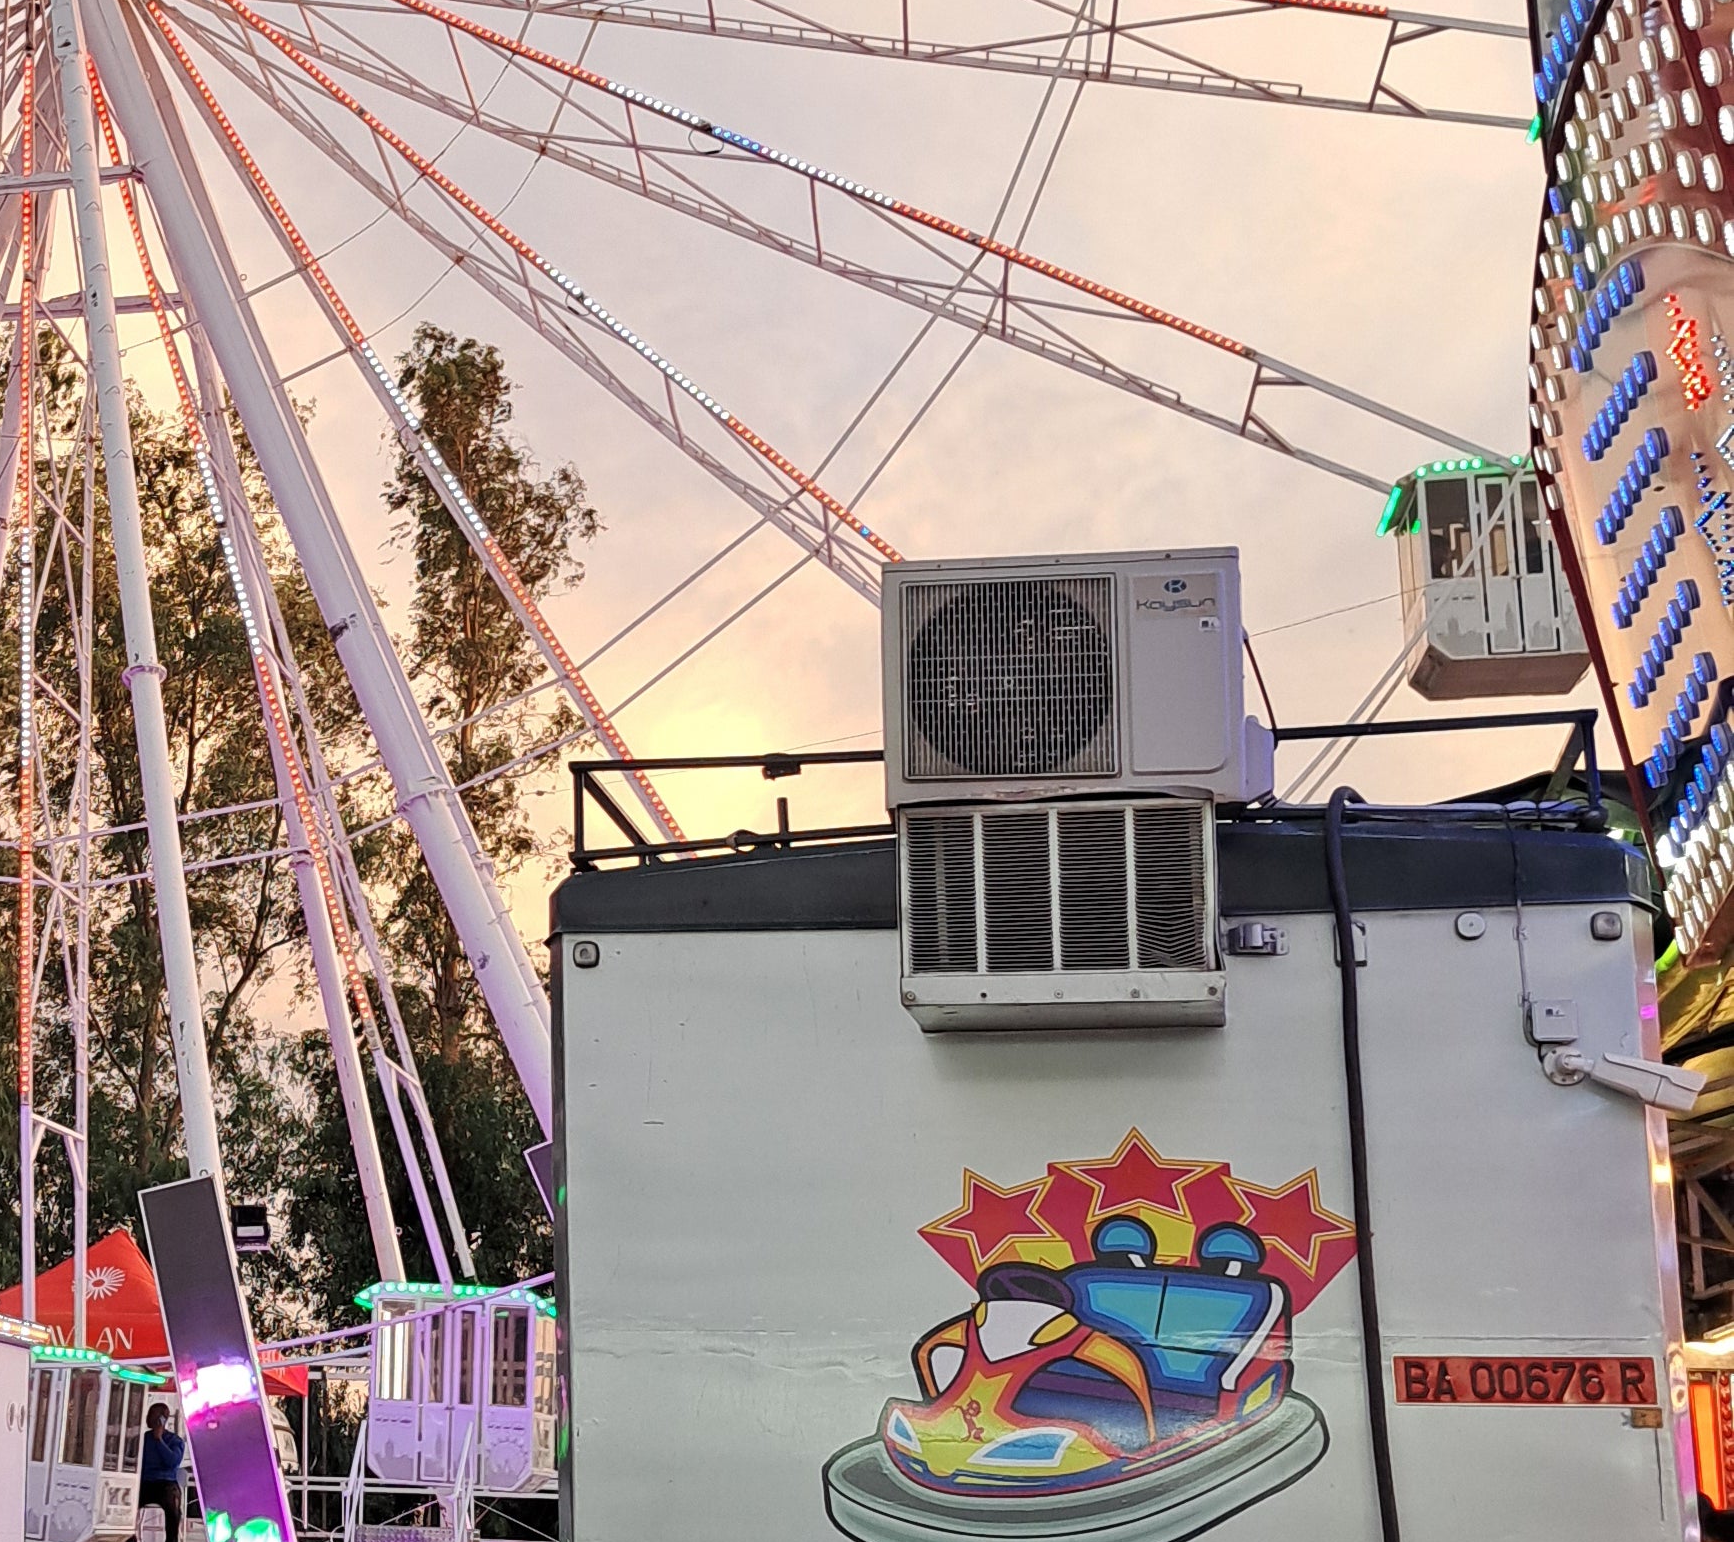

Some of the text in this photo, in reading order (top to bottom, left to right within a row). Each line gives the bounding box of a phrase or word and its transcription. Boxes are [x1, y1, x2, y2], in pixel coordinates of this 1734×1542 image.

[1403, 1361, 1648, 1402] BA 00676 R
